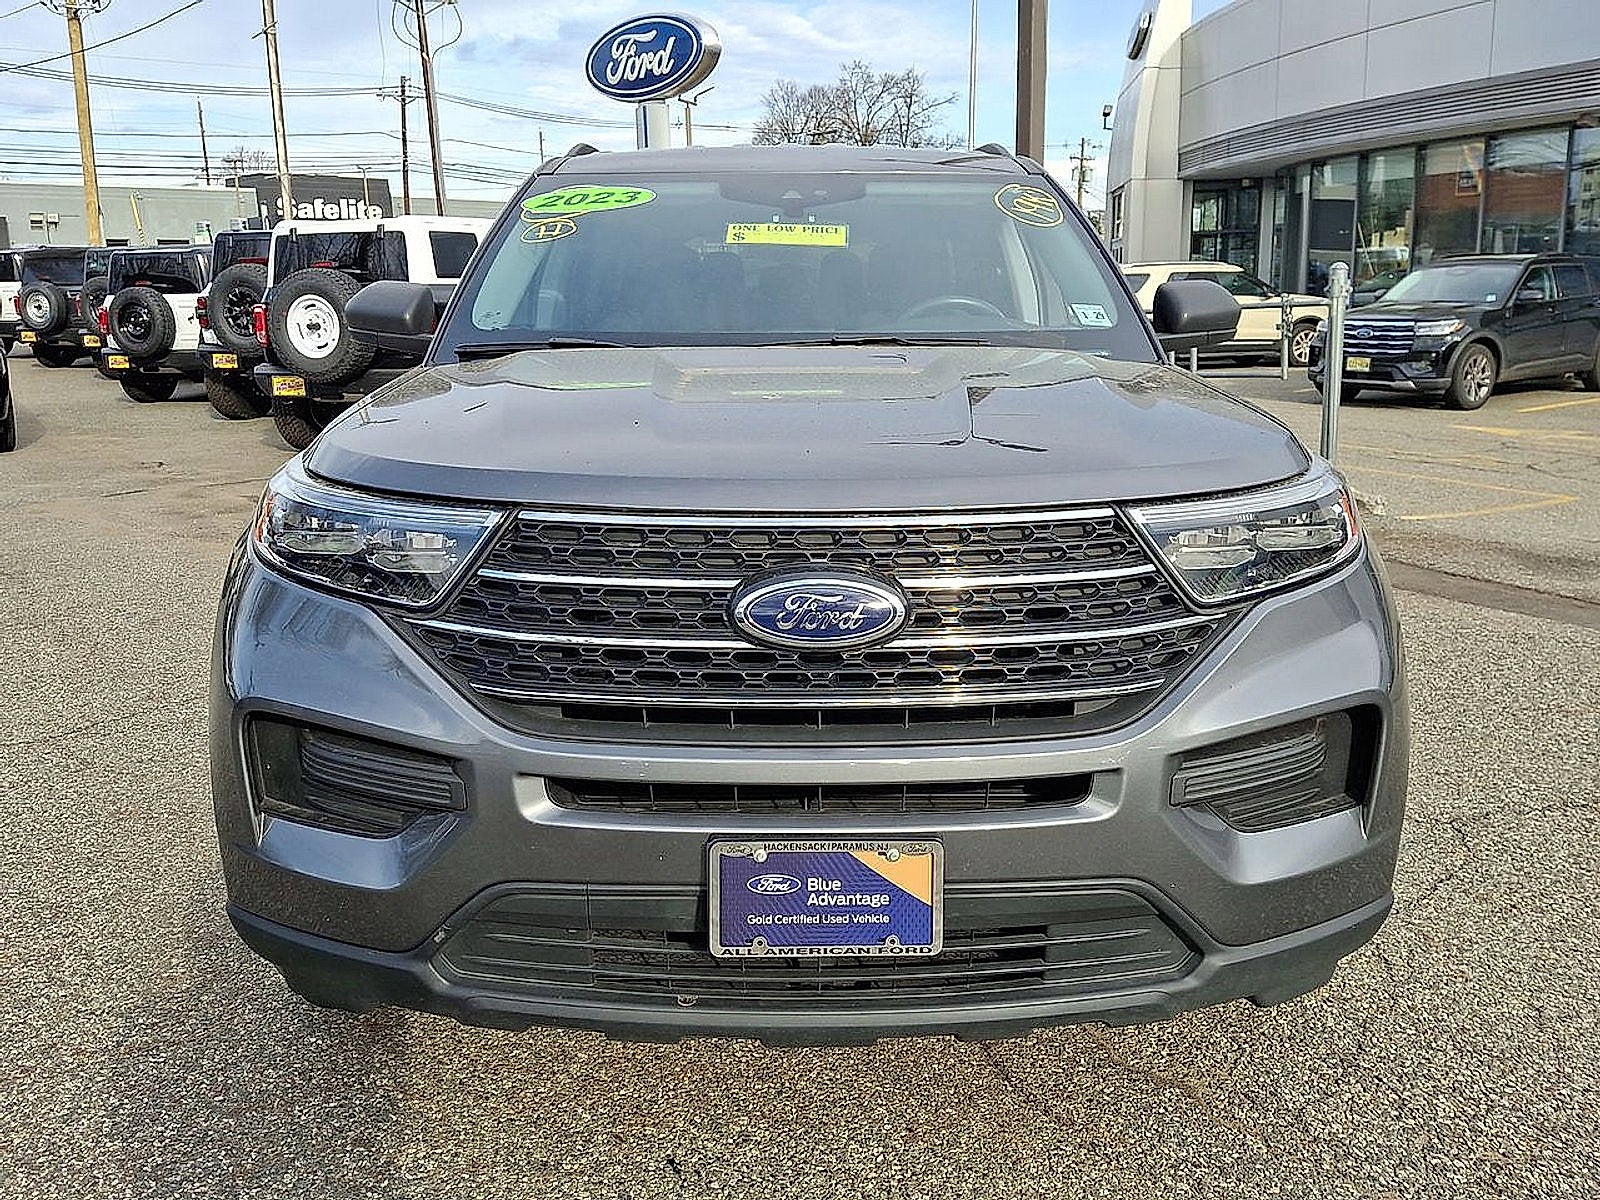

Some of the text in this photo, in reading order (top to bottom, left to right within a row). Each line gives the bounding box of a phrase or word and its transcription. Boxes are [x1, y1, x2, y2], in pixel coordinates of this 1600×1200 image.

[606, 29, 677, 85] Ford
[534, 190, 642, 209] 2023
[275, 197, 383, 220] Safelite
[767, 225, 797, 233] LOW
[731, 232, 747, 242] $
[775, 592, 868, 631] Ford
[757, 877, 792, 892] Ford
[807, 876, 842, 891] Blue
[807, 891, 890, 908] Advantage
[747, 913, 890, 925] Gold Certified Used Vehicle
[720, 946, 933, 956] ALL AMERICAN FORD
